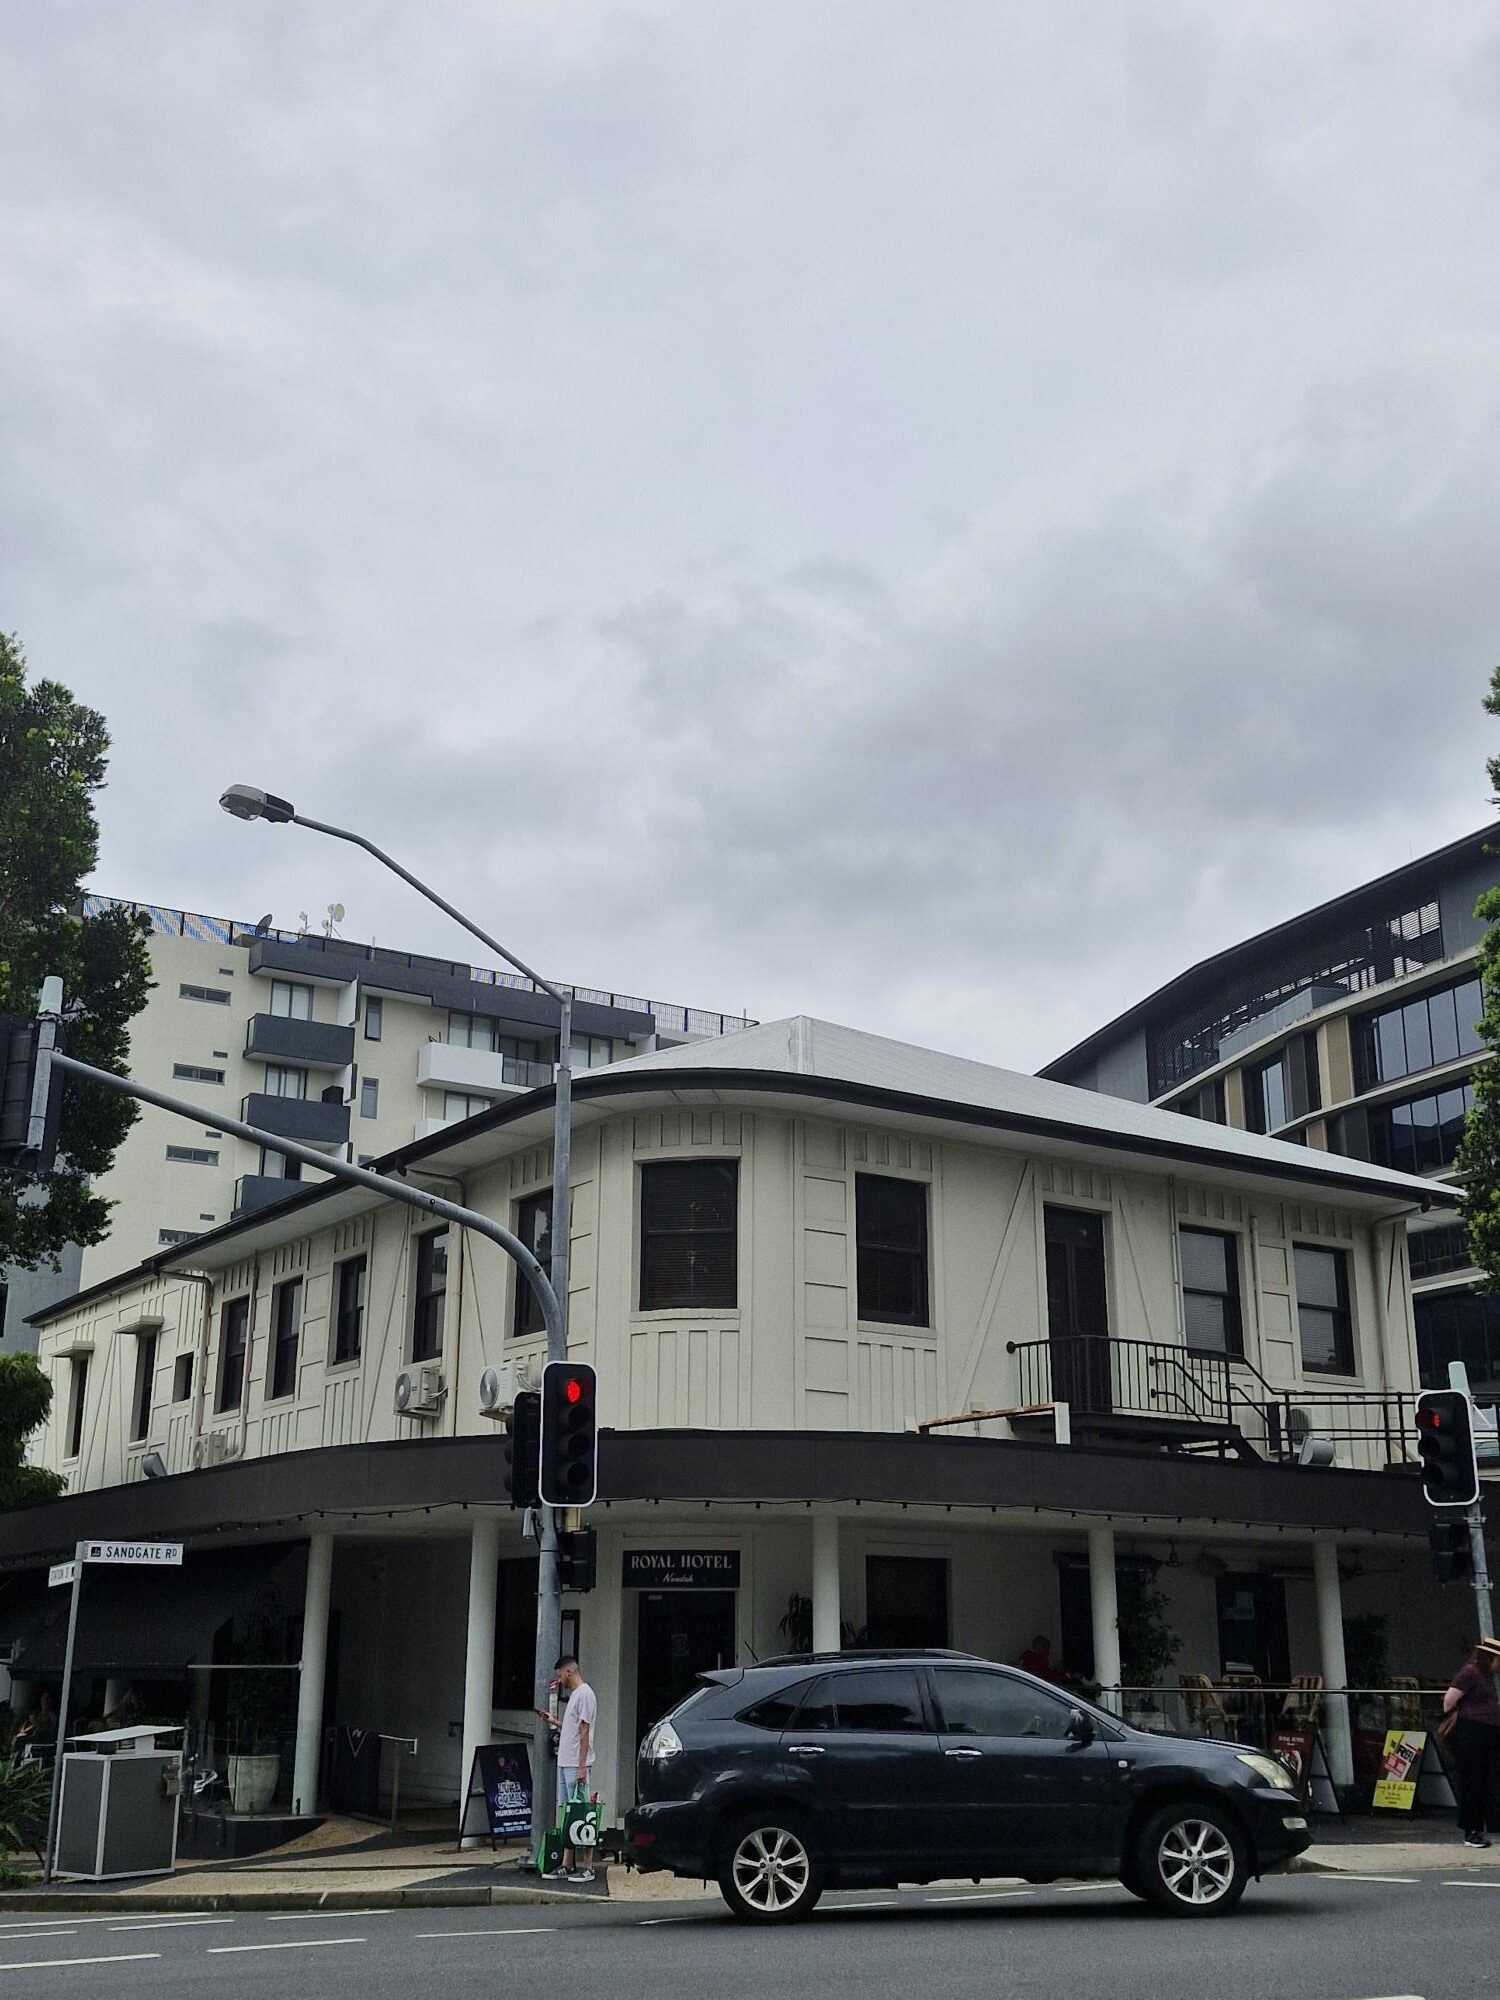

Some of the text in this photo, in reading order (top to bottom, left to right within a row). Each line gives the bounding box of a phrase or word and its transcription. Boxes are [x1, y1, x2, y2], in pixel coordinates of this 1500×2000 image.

[106, 1546, 161, 1559] SANDGATE
[631, 1554, 733, 1569] ROYAL HOTEL
